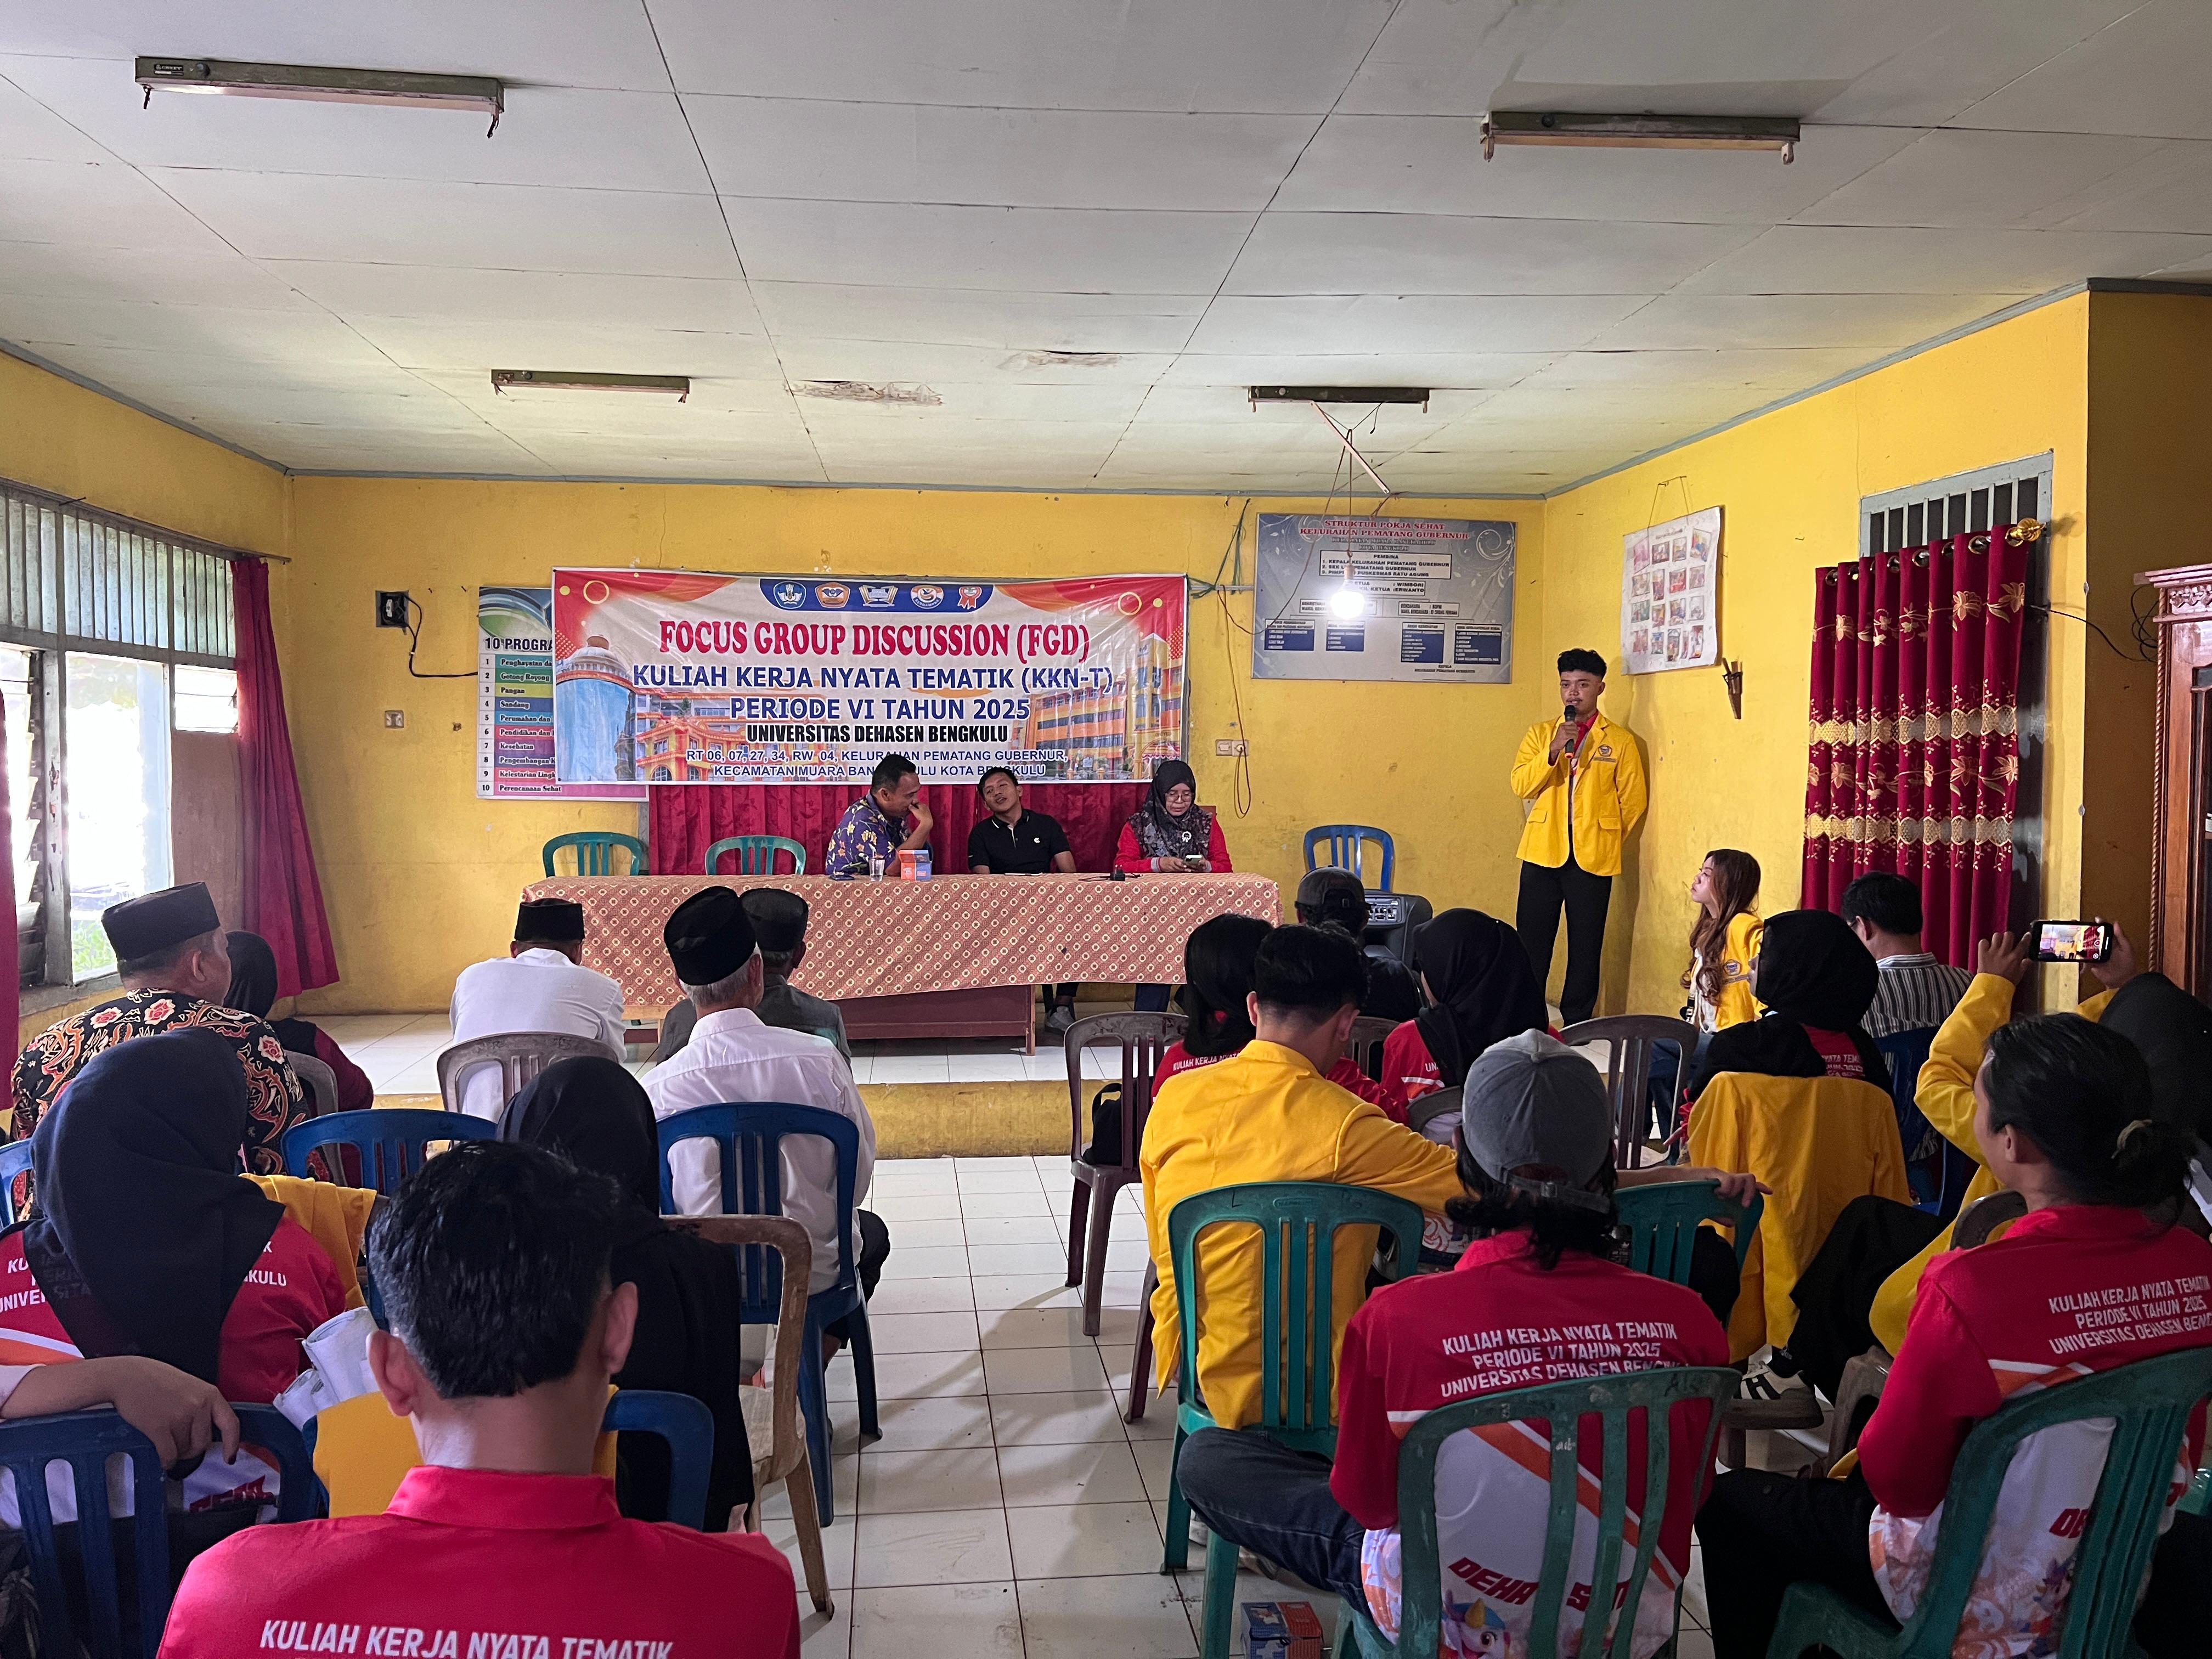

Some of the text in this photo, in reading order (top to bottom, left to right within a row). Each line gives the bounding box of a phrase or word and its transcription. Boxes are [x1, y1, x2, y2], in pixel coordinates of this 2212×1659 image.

[1417, 531, 1469, 539] GUBERNUR
[485, 637, 552, 651] 10 PROGRA
[660, 620, 1089, 663] FOCUS GROUP DISCUSSION (FGD)
[526, 674, 550, 682] Royong
[633, 665, 1113, 693] KULIAH KERJA NYATA TEMATIK (KKN-T)
[731, 698, 1030, 719] PERIODE VI TAHUN 2025
[747, 725, 1008, 743] UNIVERSITAS DEHASEN BENGKULU
[500, 757, 549, 765] Pengembangan
[687, 751, 1068, 763] RT 06, 07, 27, 34, RW 04, KELURAN PEMATANG GUBERNUR,
[715, 765, 1044, 776] KECAMATAN MUARA BANULU KOTA BKULU
[1173, 1058, 1195, 1071] KULIAH
[1195, 1056, 1217, 1066] KERJA
[2049, 1291, 2101, 1314] KULIAH
[2101, 1286, 2140, 1306] KERJA
[2141, 1280, 2175, 1300] NYATA
[2075, 1306, 2132, 1329] PERIODE
[2129, 1305, 2142, 1321] VI
[2142, 1299, 2181, 1319] TAHUN
[1442, 1322, 1678, 1356] KULIAH KERJA NYATA TEMATIK
[2049, 1326, 2136, 1355] UNIVERSITAS
[2135, 1318, 2186, 1340] DEHASEN
[1472, 1342, 1661, 1370] PERIODE VI TAHUN 2025
[1441, 1366, 1543, 1398] UNIVERSITAS
[1546, 1361, 1621, 1380] DEHASEN
[259, 1620, 674, 1659] KULIAH KERJA NYATA TEMATIK
